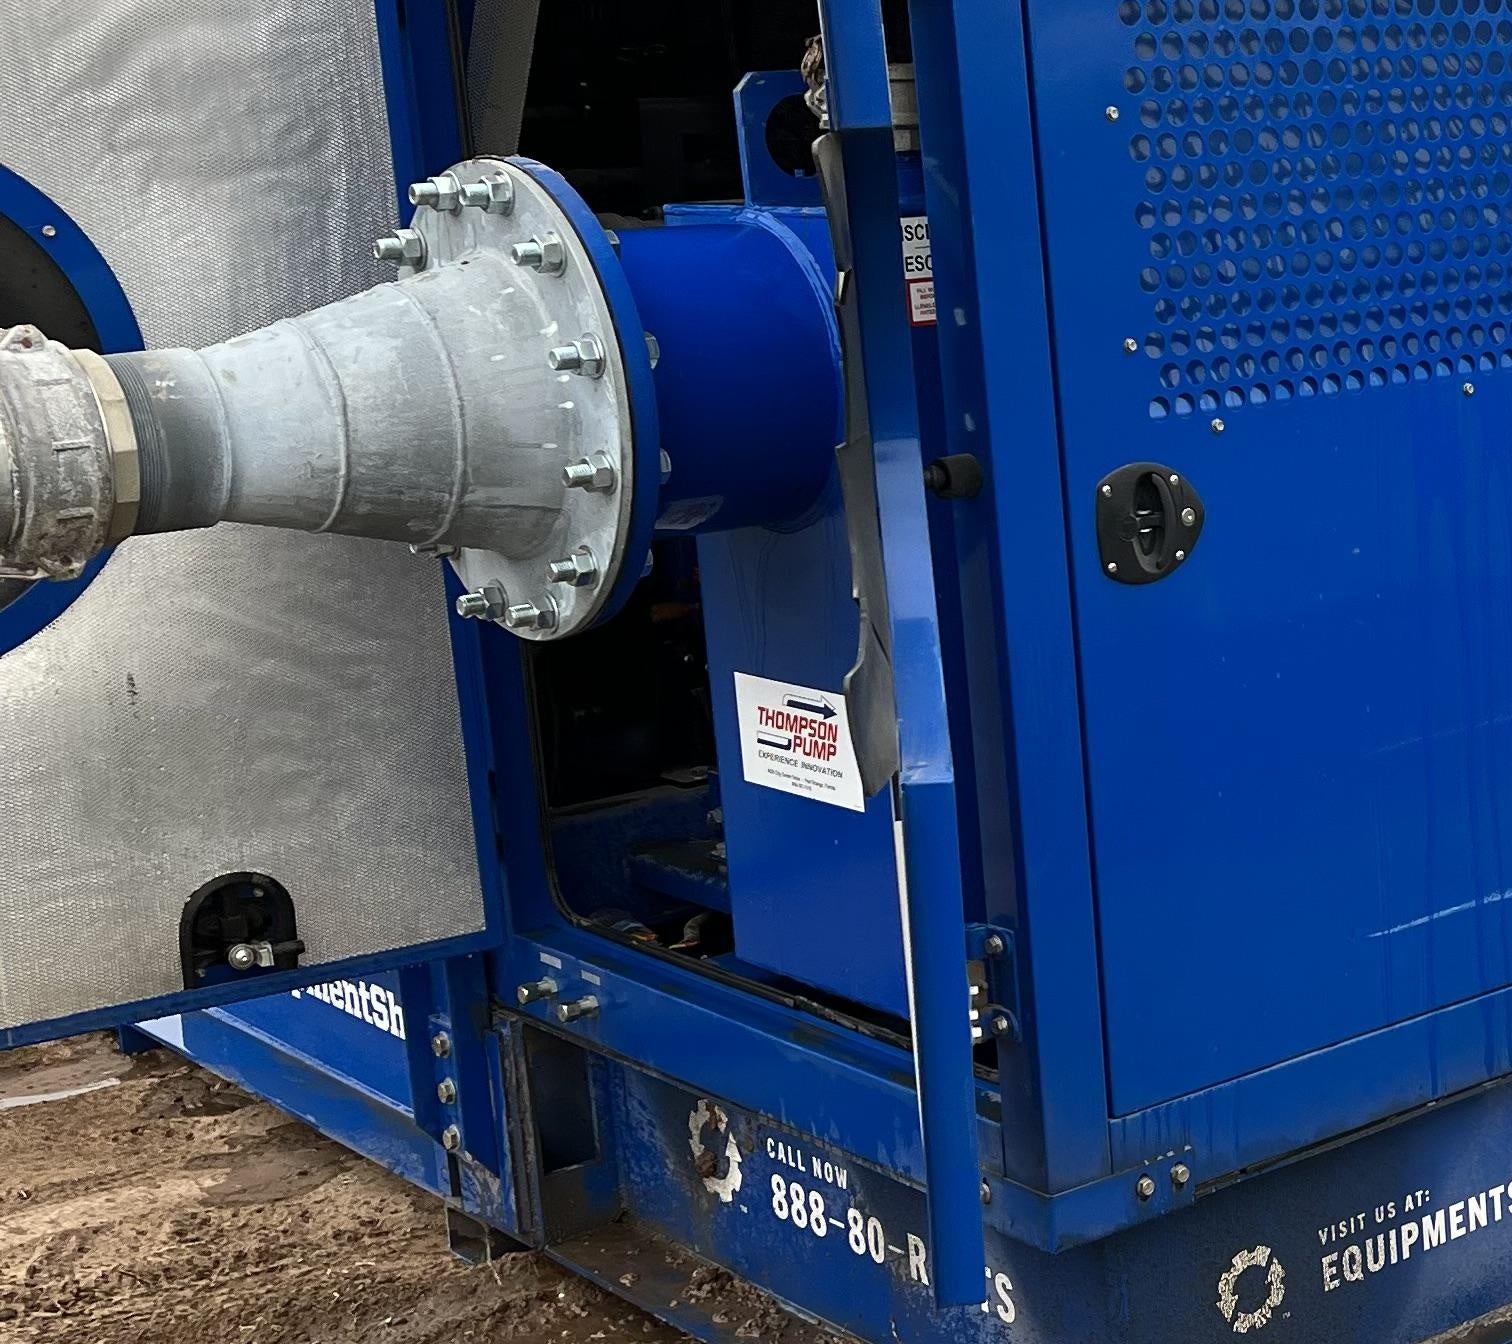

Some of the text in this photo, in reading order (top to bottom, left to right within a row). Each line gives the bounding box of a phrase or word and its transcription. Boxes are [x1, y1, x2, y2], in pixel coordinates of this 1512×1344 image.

[905, 254, 933, 272] ESC
[757, 705, 839, 744] THOMPSON
[792, 734, 837, 762] PUMP
[766, 1137, 848, 1190] CALL NOW
[1318, 1189, 1432, 1247] VISIT US AT:
